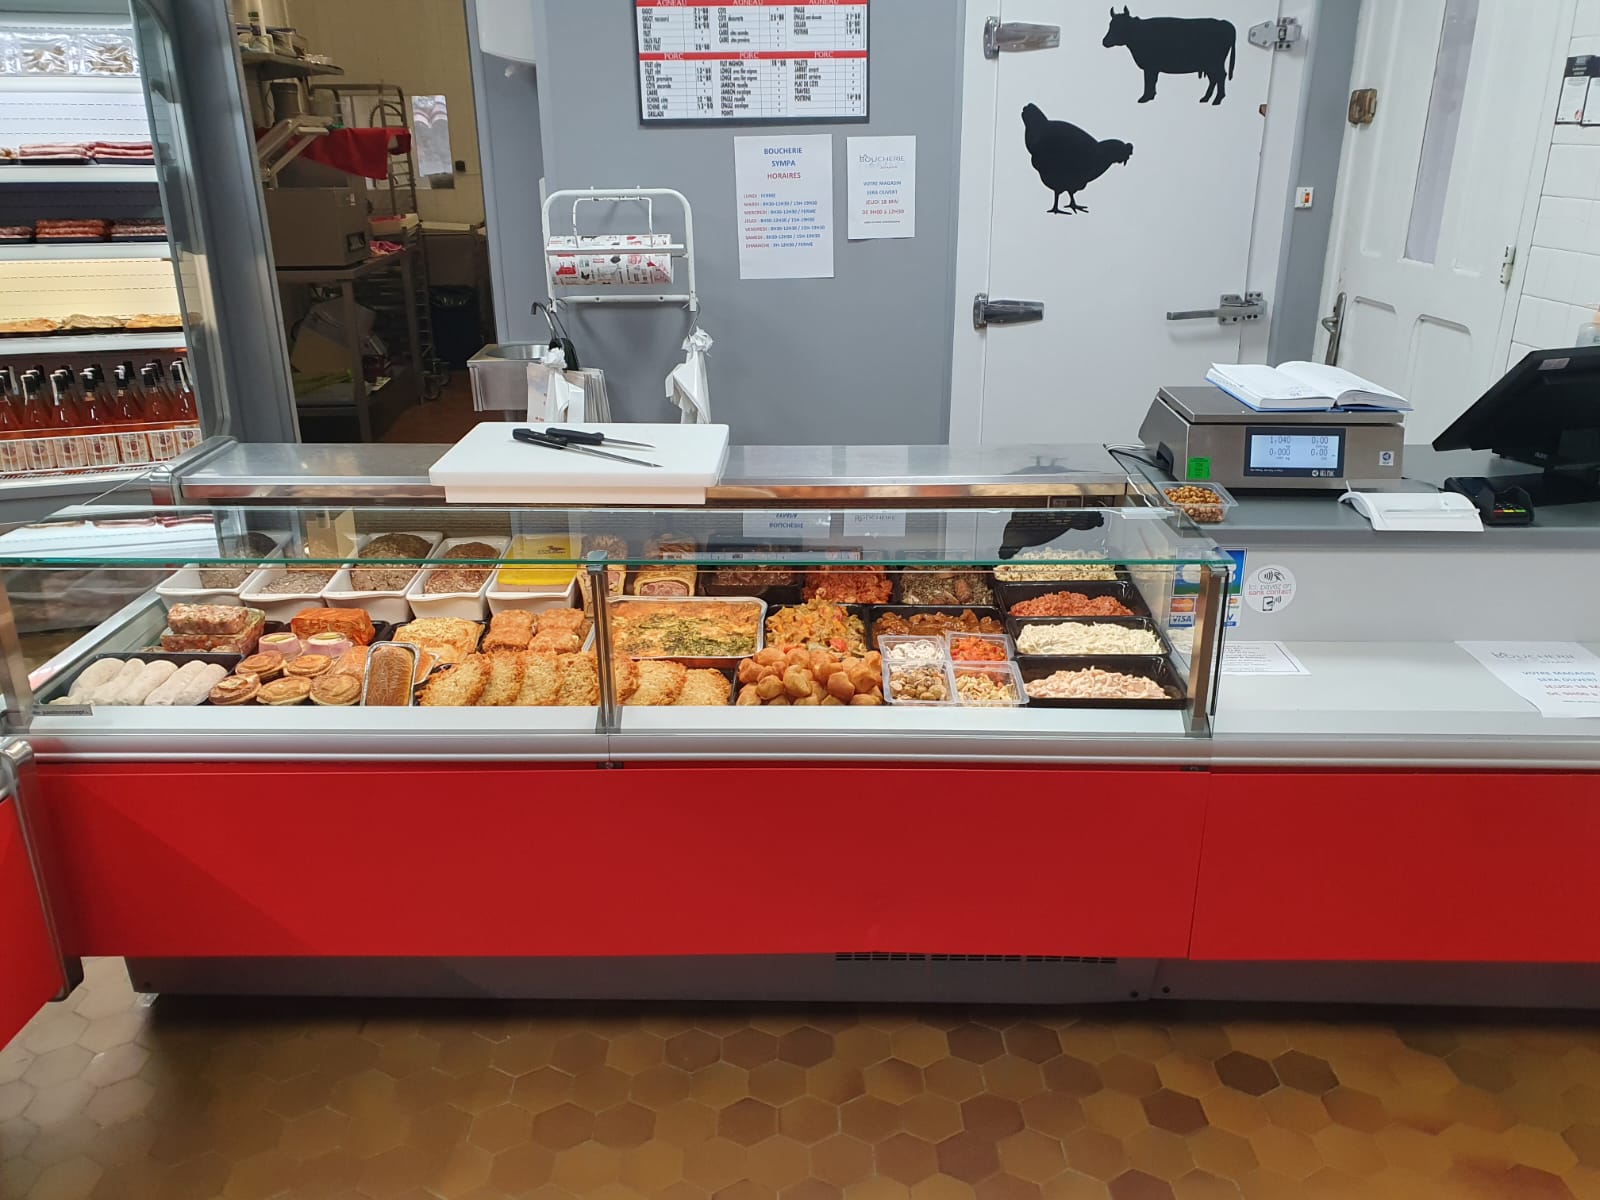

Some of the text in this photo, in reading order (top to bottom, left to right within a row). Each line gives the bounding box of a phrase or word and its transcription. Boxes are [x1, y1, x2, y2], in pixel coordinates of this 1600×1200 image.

[740, 52, 760, 60] PORC
[764, 147, 803, 155] BOUCHERIE
[772, 160, 796, 168] SYMPA
[768, 172, 801, 180] HORAIRES
[1172, 615, 1192, 623] VISA
